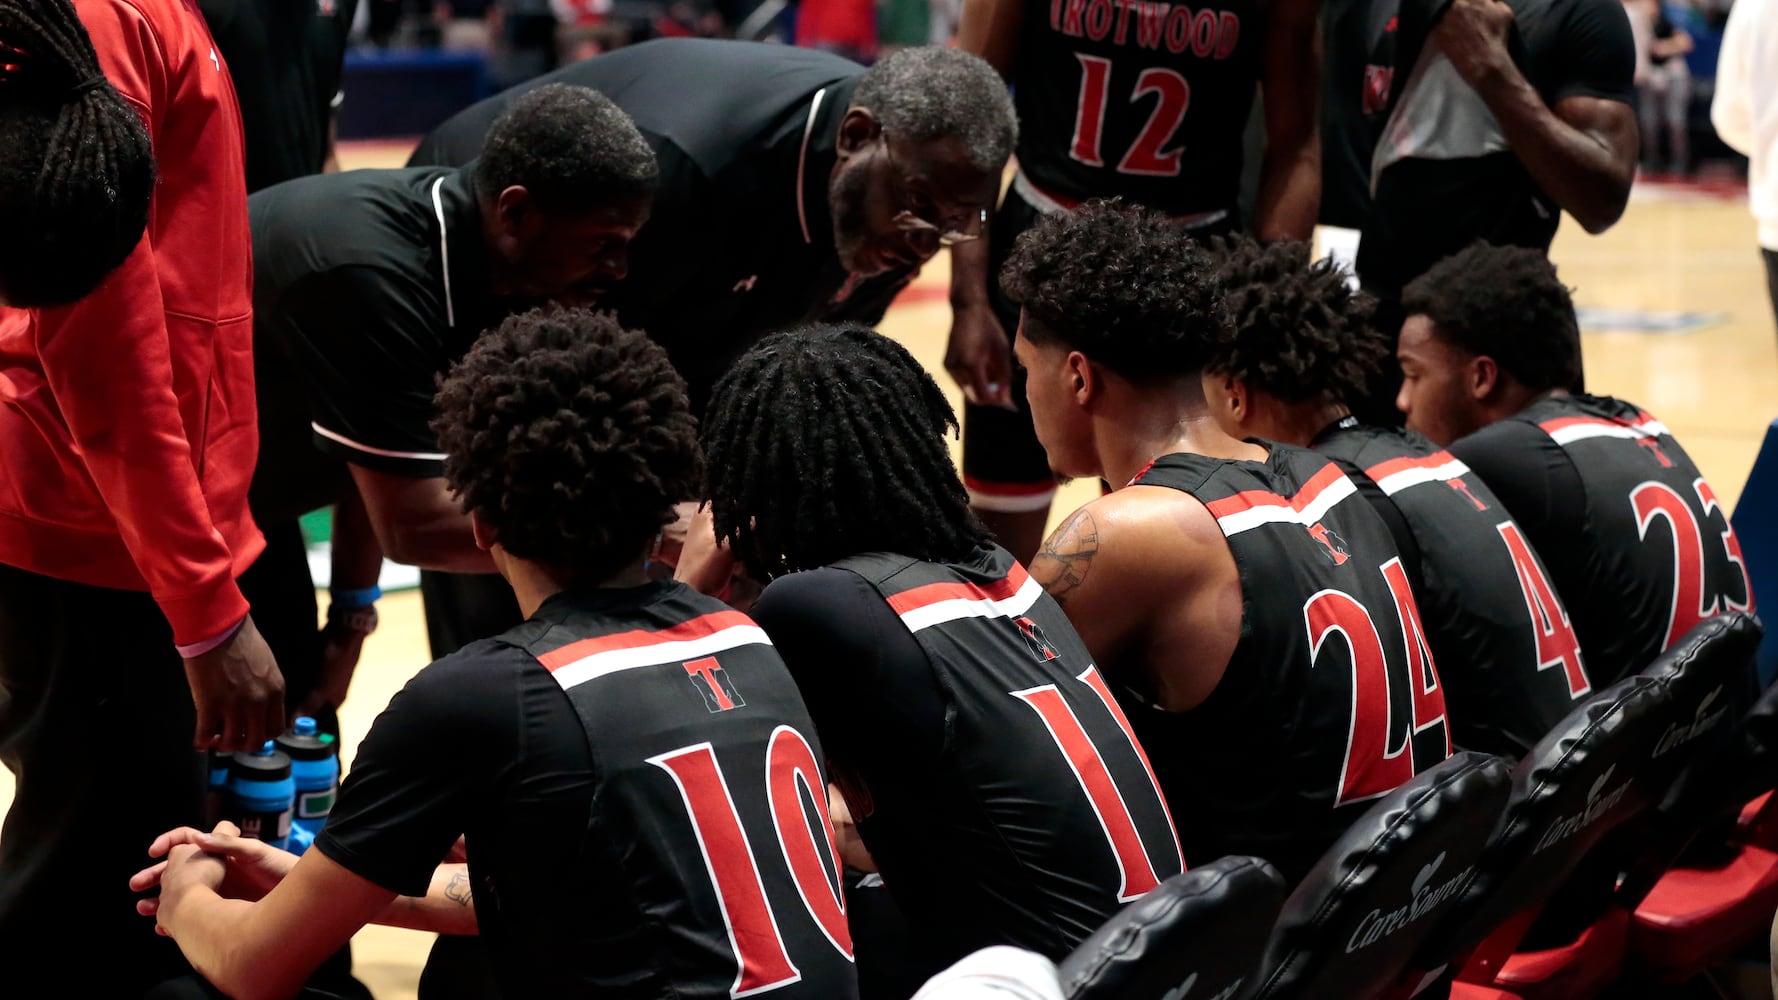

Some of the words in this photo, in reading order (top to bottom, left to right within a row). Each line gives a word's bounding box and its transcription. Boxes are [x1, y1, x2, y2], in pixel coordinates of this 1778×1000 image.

[1069, 52, 1191, 177] 12
[1495, 519, 1592, 701] 4
[1629, 477, 1757, 654] 23
[1008, 663, 1189, 904] 11
[1303, 555, 1454, 809] 24
[644, 724, 856, 1000] 10
